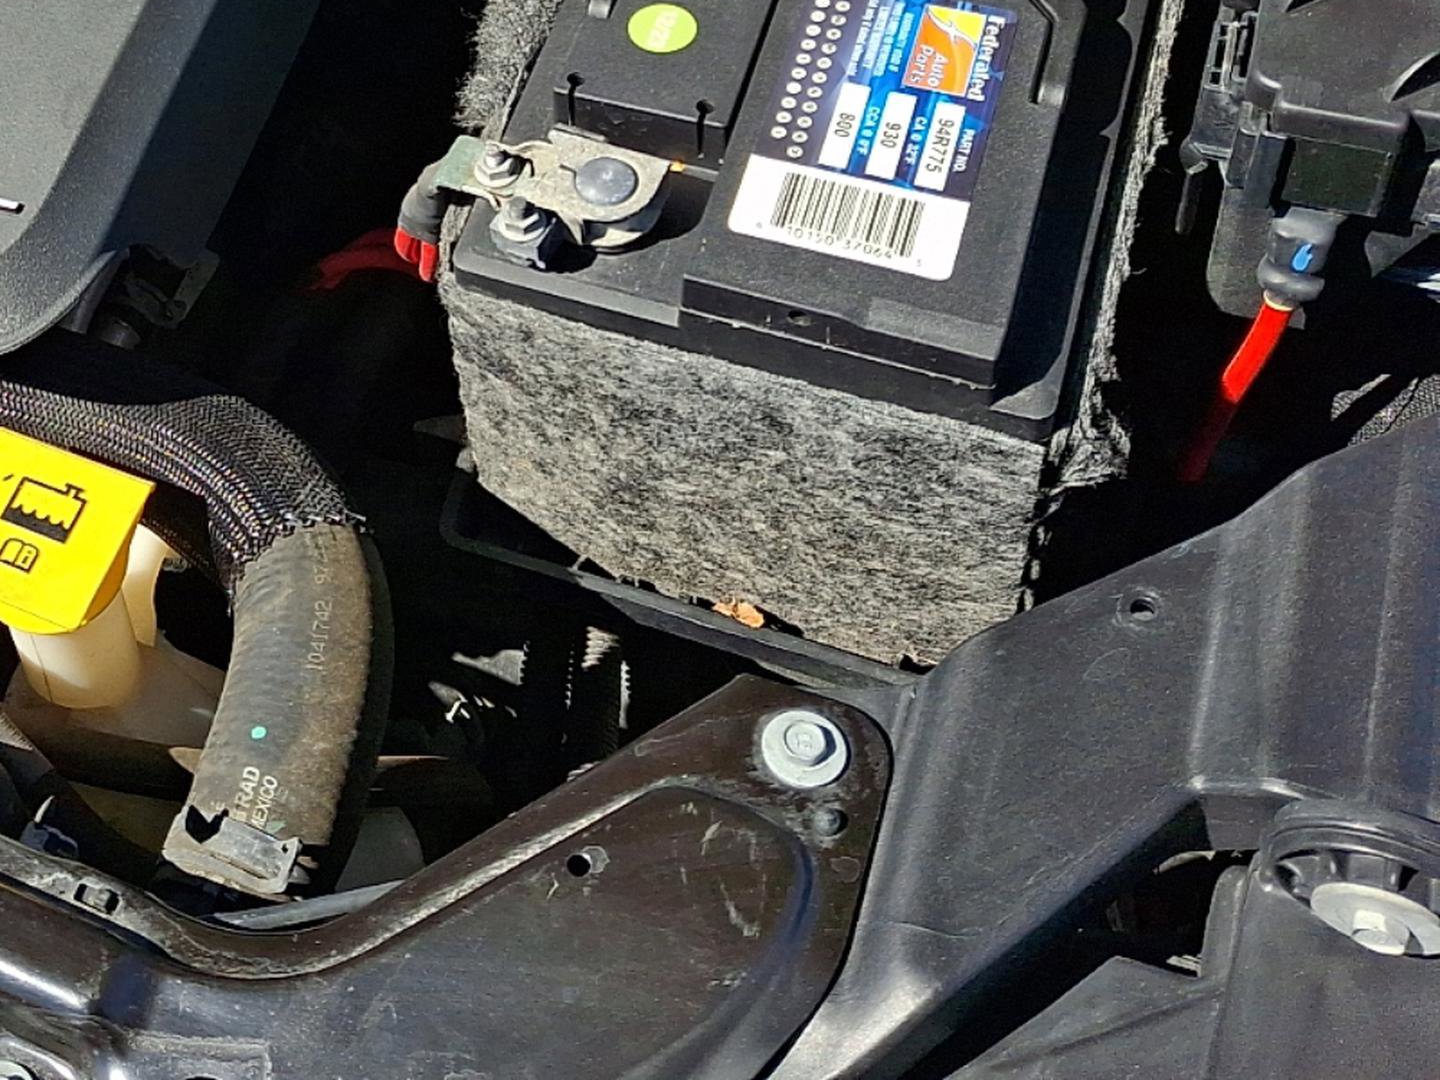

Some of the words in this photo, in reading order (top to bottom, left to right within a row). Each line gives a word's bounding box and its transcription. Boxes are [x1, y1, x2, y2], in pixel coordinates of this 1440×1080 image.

[908, 43, 935, 84] Parts
[925, 52, 950, 88] Auto
[965, 14, 1006, 102] Federated
[832, 111, 855, 138] 800
[863, 105, 880, 128] CCA
[912, 115, 927, 131] CA
[879, 121, 902, 149] 930
[924, 117, 955, 174] 94R775
[956, 127, 974, 156] PART
